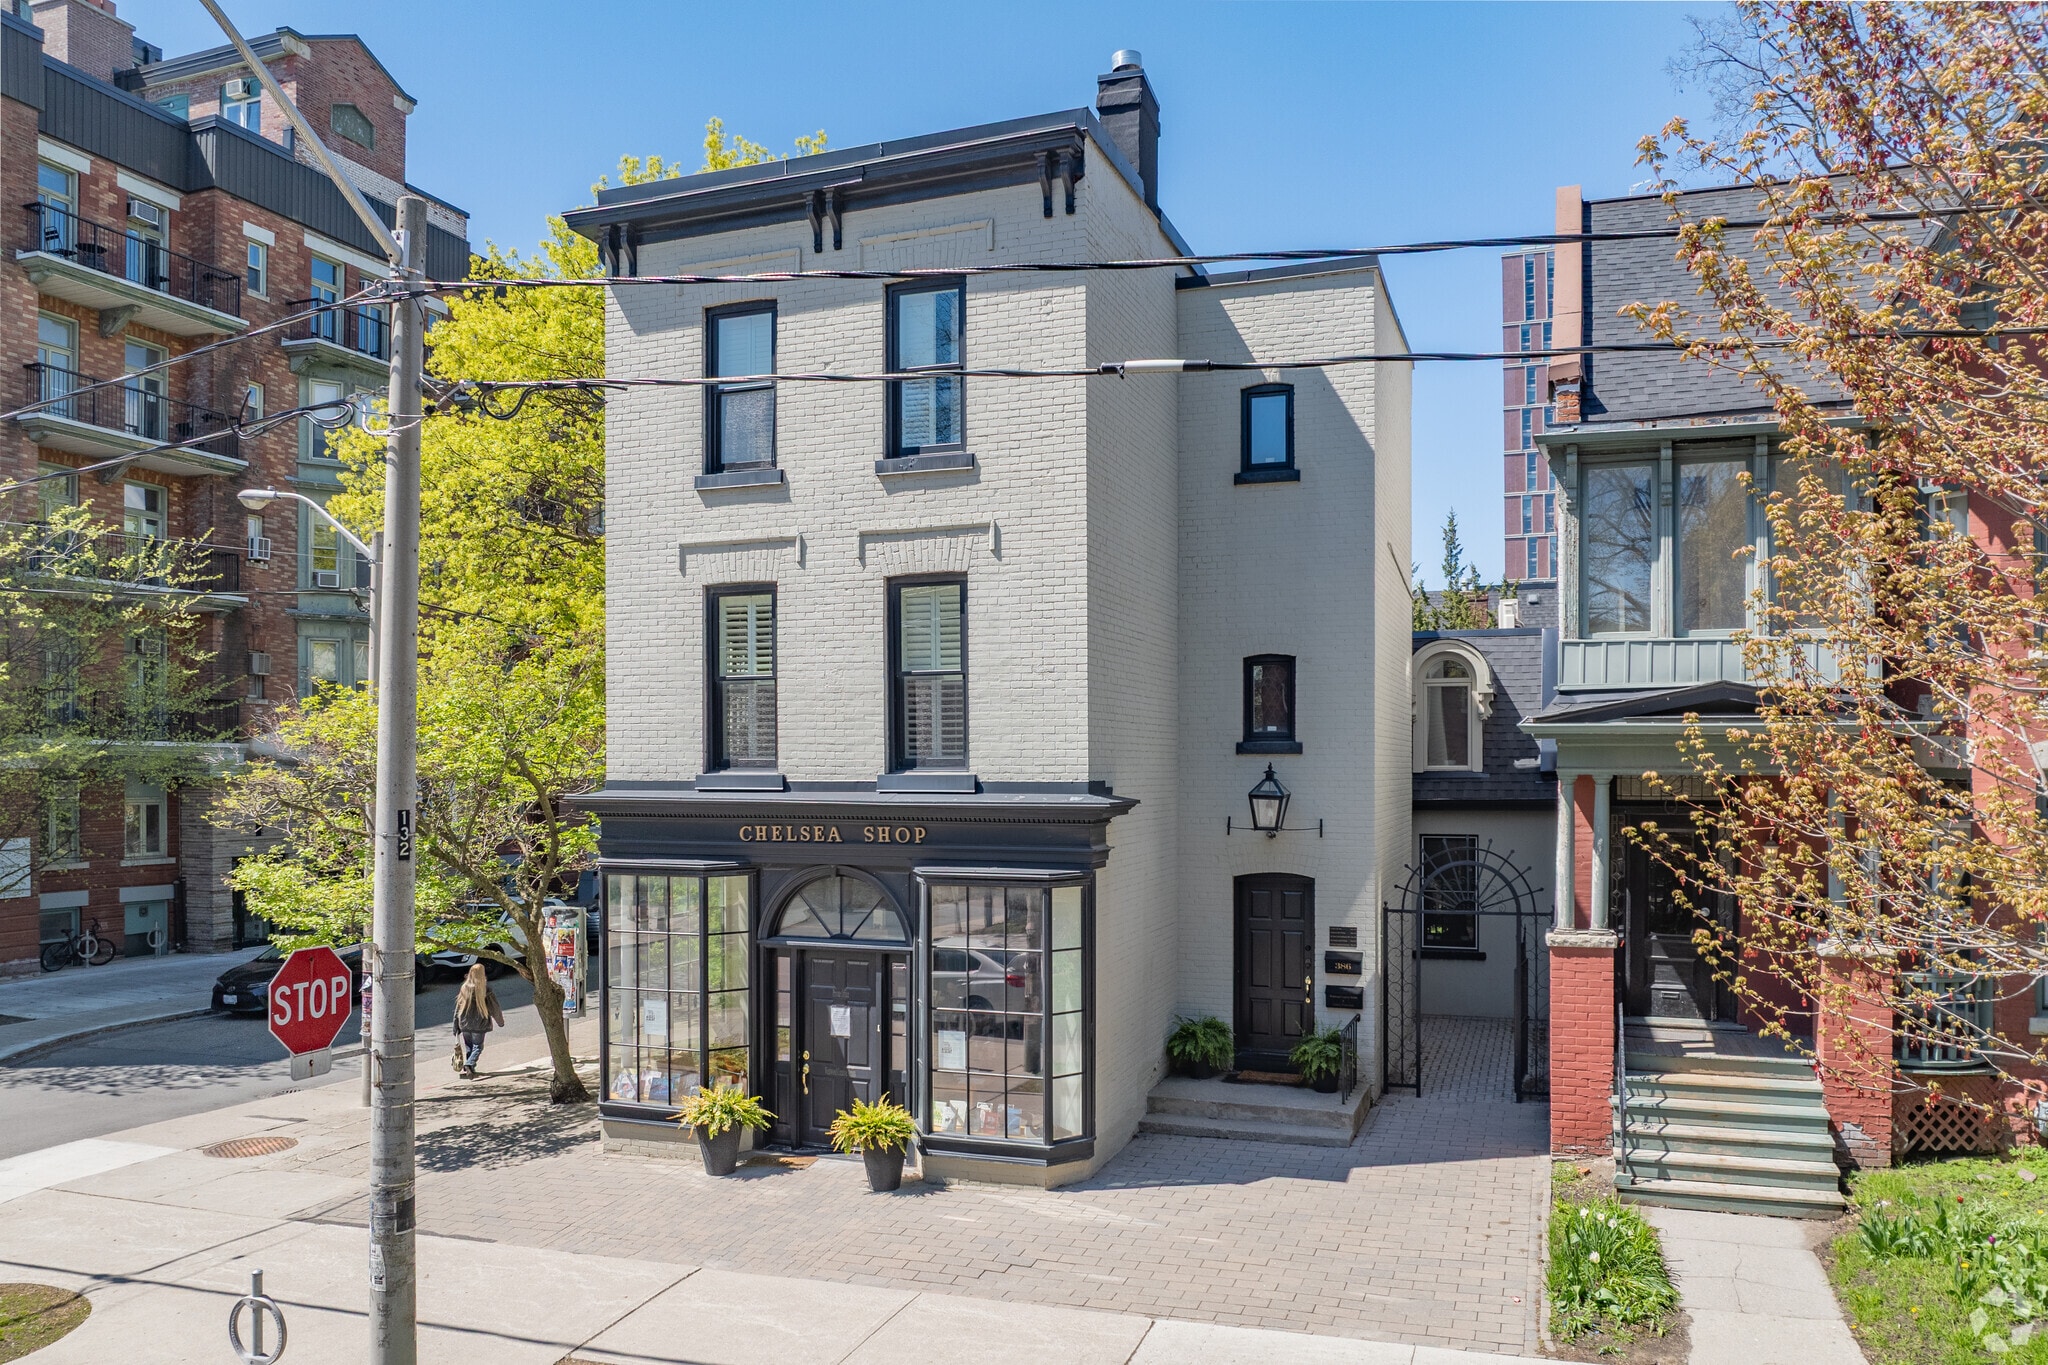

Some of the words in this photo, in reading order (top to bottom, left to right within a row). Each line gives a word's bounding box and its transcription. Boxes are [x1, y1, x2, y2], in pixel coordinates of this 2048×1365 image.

[400, 811, 409, 856] 132
[739, 825, 842, 843] CHELSEA
[863, 826, 927, 844] SHOP
[273, 975, 348, 1026] STOP
